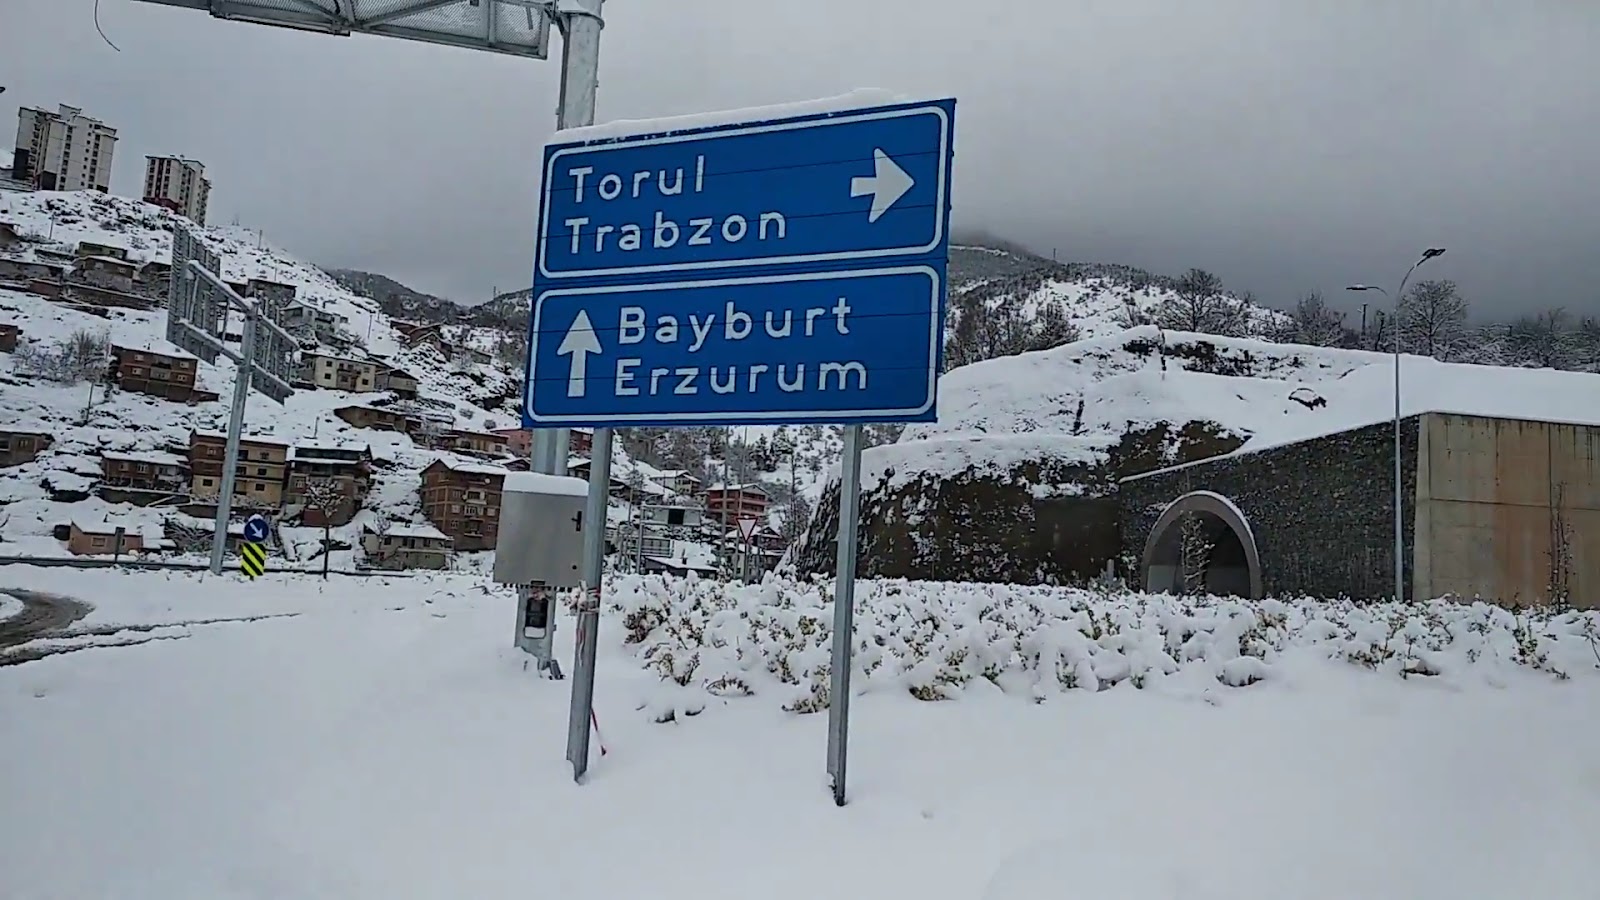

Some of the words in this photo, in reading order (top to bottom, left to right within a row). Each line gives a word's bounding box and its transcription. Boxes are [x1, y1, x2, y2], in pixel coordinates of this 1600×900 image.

[568, 155, 705, 203] Torul
[564, 210, 787, 254] Trabzon
[618, 297, 852, 352] Bayburt
[615, 358, 868, 397] Erzurum
